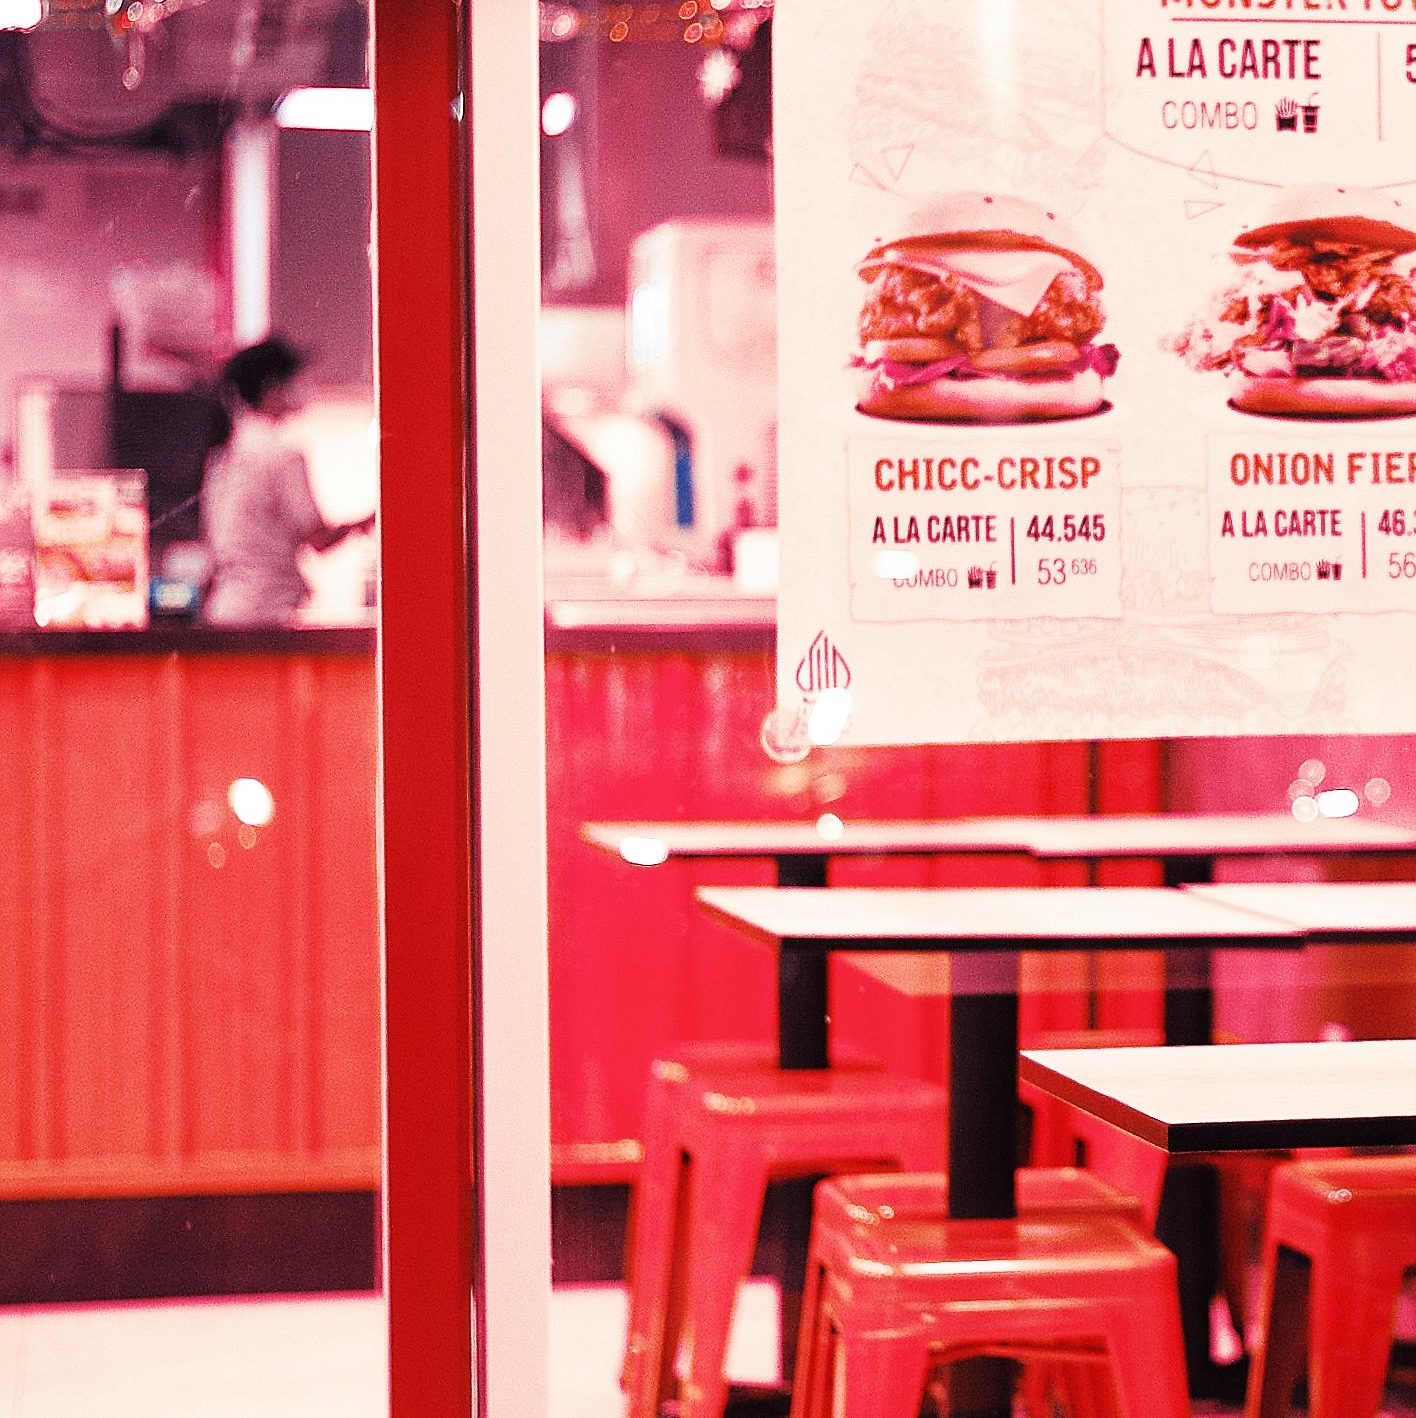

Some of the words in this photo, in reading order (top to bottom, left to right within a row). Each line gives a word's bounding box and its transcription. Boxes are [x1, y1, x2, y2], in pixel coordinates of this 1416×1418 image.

[1135, 36, 1157, 78] A
[1167, 37, 1208, 79] LA
[1217, 37, 1322, 81] CARTE
[1162, 100, 1258, 131] COMBO
[874, 456, 1101, 492] CHICC-CRISP
[1230, 452, 1335, 487] ONION
[872, 516, 887, 544] A
[893, 515, 921, 544] LA
[927, 514, 997, 544] CARTE
[1026, 513, 1106, 543] 44.545
[1221, 510, 1235, 538] A
[1241, 509, 1268, 538] LA
[1274, 508, 1343, 538] CARTE
[1248, 561, 1312, 582] COMBO
